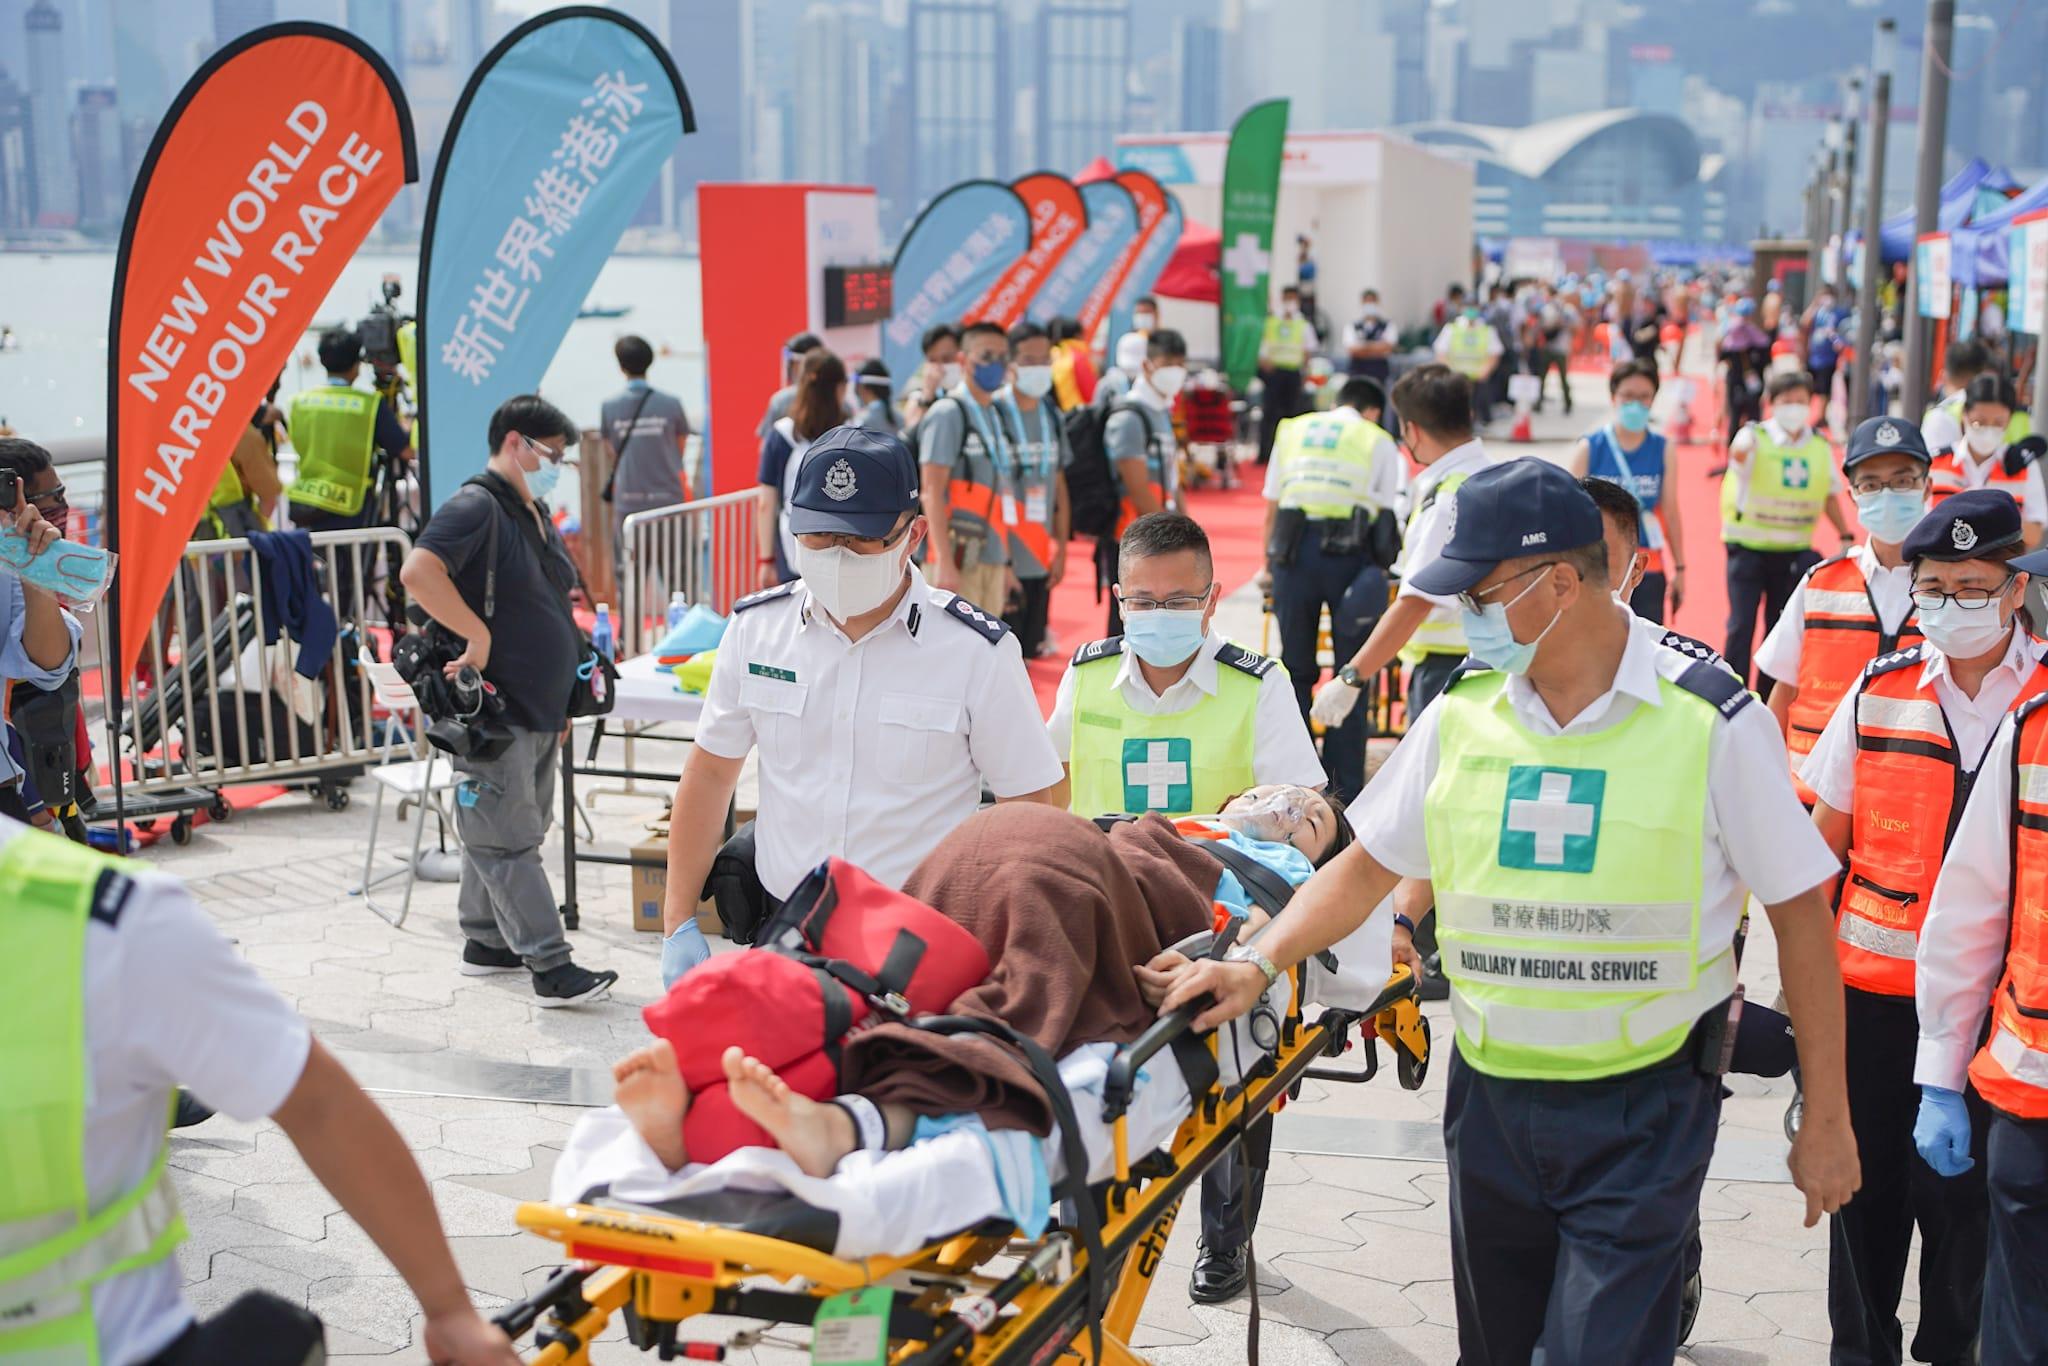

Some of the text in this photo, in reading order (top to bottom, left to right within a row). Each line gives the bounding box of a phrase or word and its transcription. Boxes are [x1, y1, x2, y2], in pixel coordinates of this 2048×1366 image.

[441, 69, 648, 386] 新世界維港泳
[128, 100, 328, 402] NEW WORLD
[135, 273, 290, 515] HARBOUR
[271, 131, 383, 274] RACE
[1521, 531, 1548, 547] AMS
[1870, 808, 1910, 833] Nurse
[1491, 902, 1612, 933] 醫療輔助隊
[1460, 949, 1658, 982] AUXILIARY MEDICAL SERVICE
